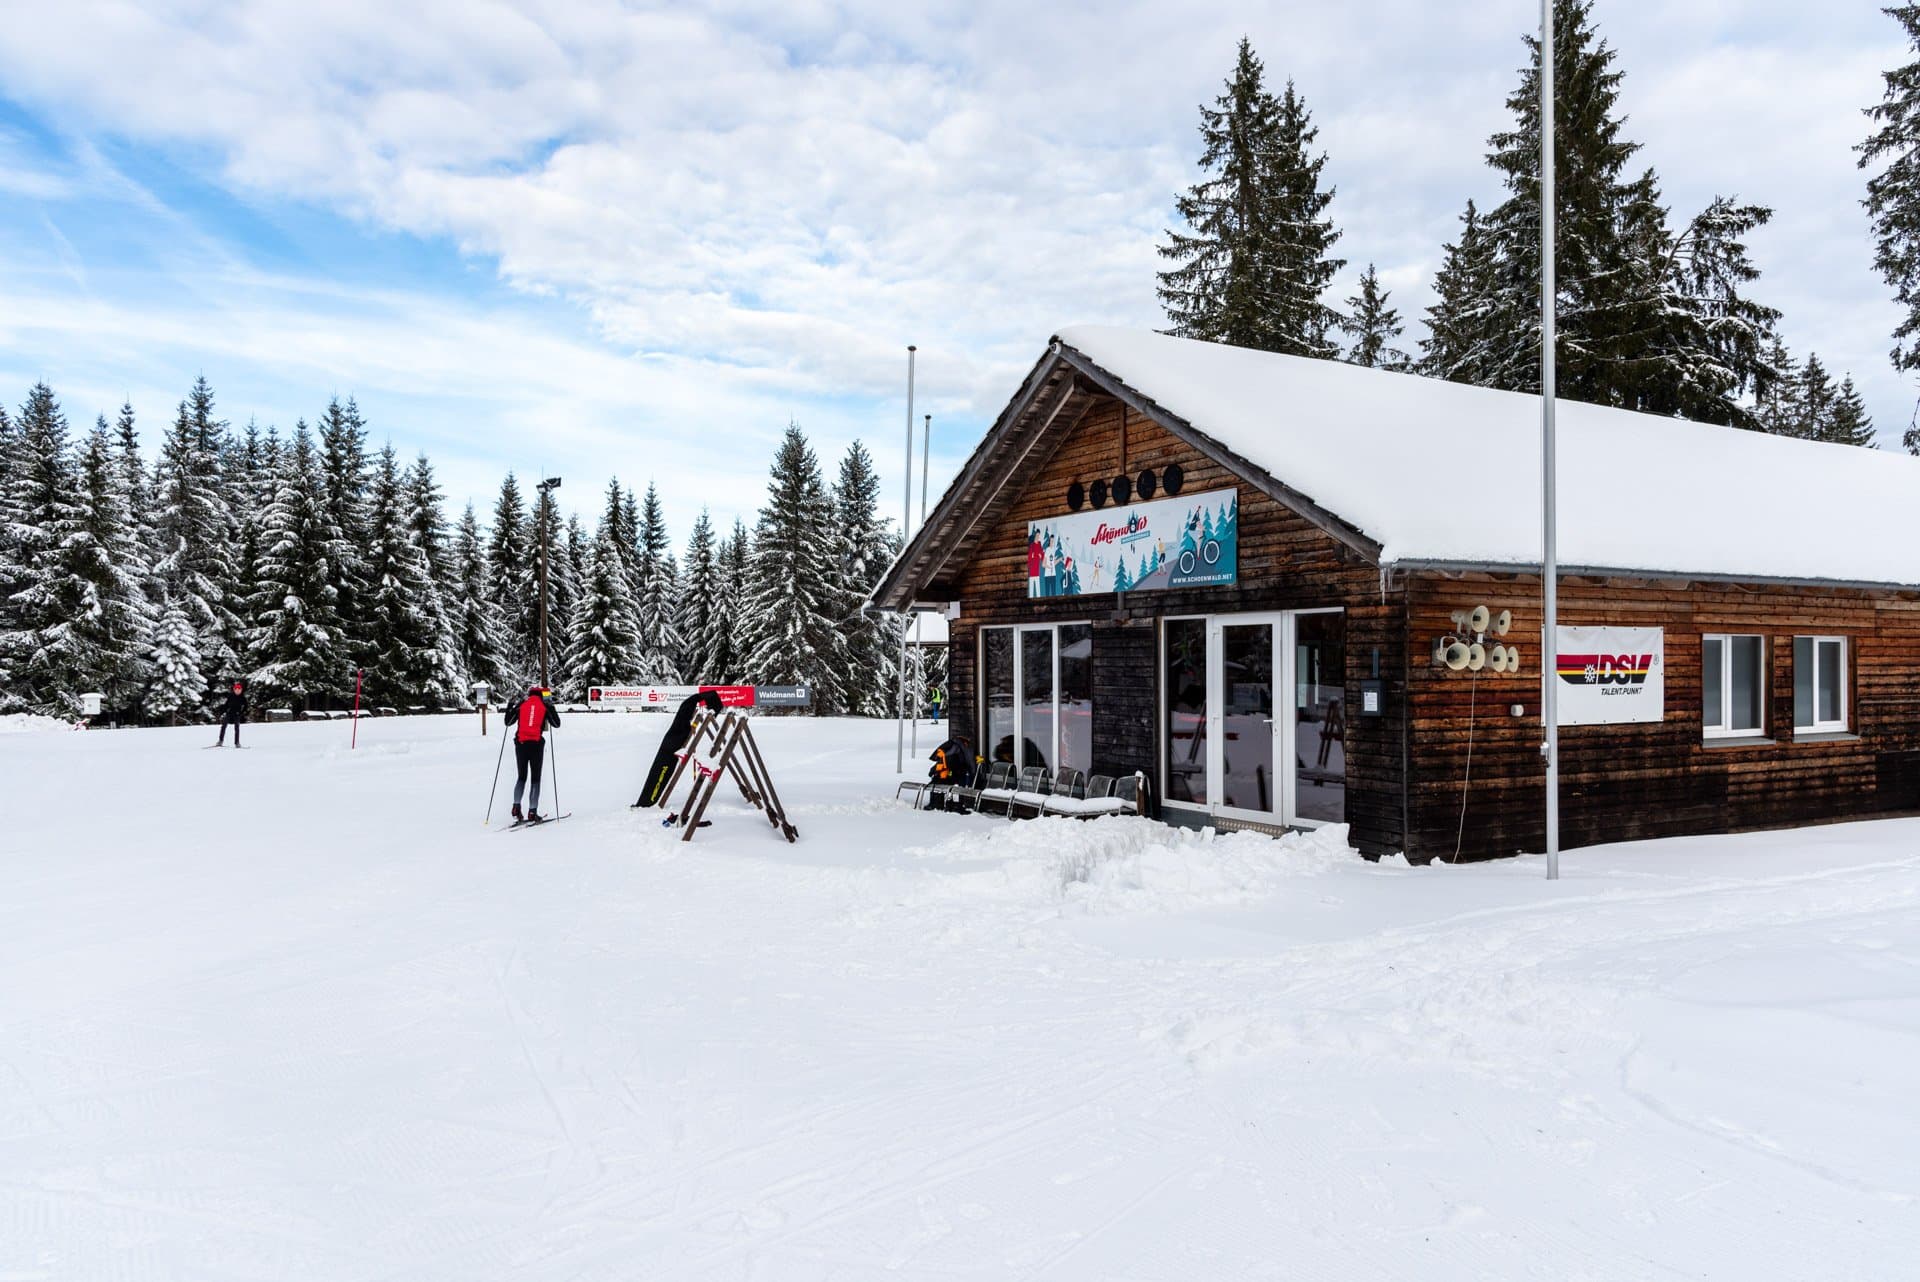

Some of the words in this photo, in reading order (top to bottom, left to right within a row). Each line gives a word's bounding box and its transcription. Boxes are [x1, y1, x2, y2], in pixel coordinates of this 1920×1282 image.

[1597, 654, 1652, 685] DSV
[758, 691, 796, 699] Waldmann
[1601, 687, 1643, 695] TALENT.PUNKT
